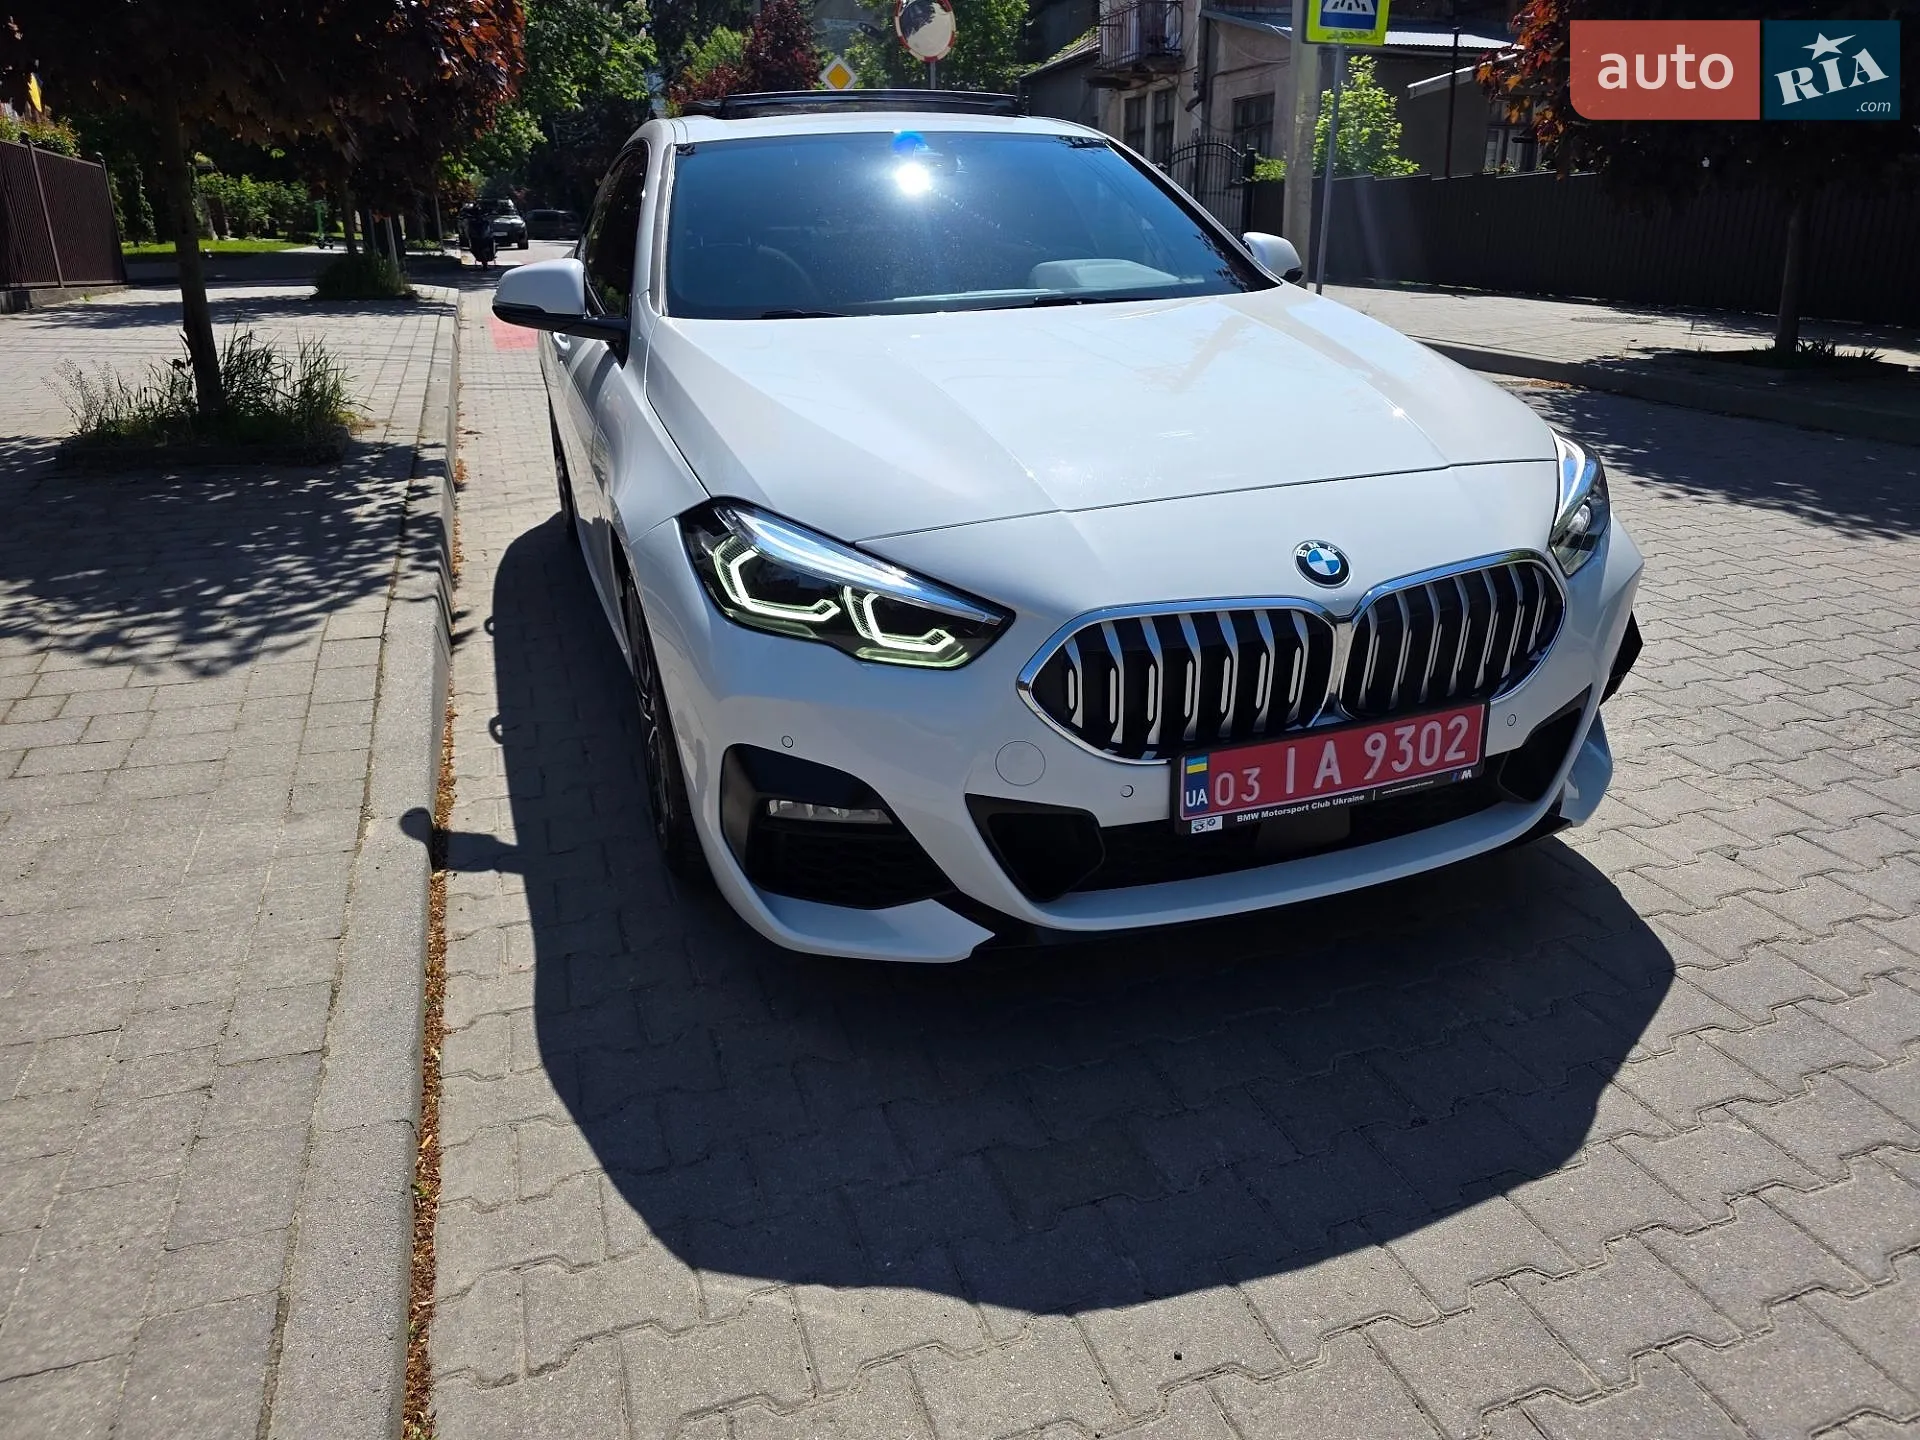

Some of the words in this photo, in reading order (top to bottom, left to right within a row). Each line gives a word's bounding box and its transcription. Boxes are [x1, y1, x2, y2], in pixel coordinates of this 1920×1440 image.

[1296, 542, 1338, 557] BMW
[1214, 767, 1261, 806] 03
[1364, 715, 1470, 780] 9302
[1185, 788, 1208, 807] UA
[1237, 812, 1260, 822] BMW
[1261, 804, 1309, 818] Motorsport
[1311, 800, 1331, 809] Club
[1332, 794, 1365, 805] Ukraine
